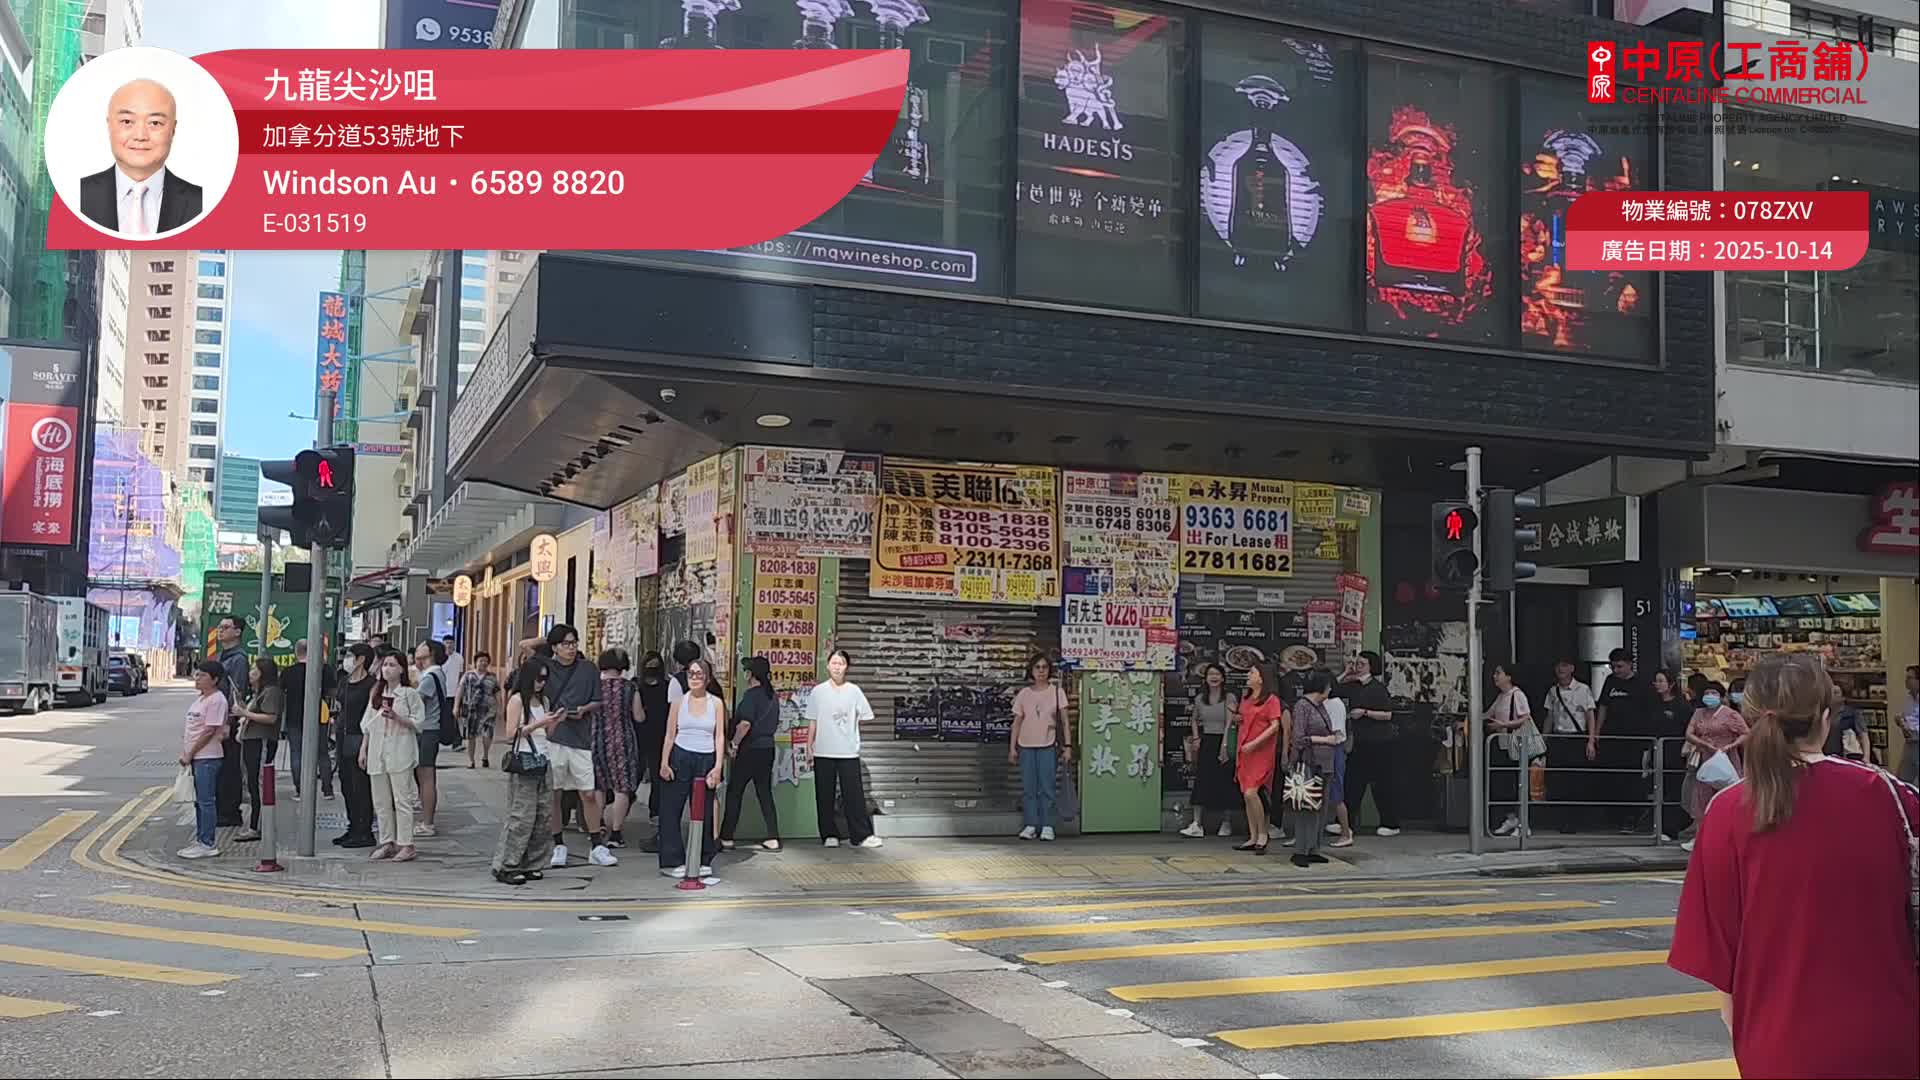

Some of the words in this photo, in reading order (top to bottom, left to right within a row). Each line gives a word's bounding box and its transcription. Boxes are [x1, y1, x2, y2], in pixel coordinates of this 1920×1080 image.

[43, 456, 64, 508] 海底撈
[1208, 480, 1247, 502] 永昇
[1251, 483, 1284, 494] Mutual
[1251, 493, 1291, 505] Property
[939, 508, 1050, 527] 8208-1838
[1096, 505, 1131, 518] 6895
[1136, 508, 1171, 520] 6018
[1186, 505, 1235, 529] 9363
[1243, 509, 1288, 532] 6681
[939, 521, 1050, 540] 8105-5645
[1096, 518, 1131, 530] 6748
[1136, 521, 1172, 533] 8306
[939, 534, 1050, 552] 8100-2396
[1187, 530, 1201, 545] 出
[1206, 531, 1227, 546] For
[1233, 533, 1271, 548] Lease
[1274, 534, 1288, 550] 租
[760, 560, 816, 575] 8208-1838
[966, 550, 1053, 570] 2311-7368
[1184, 550, 1290, 572] 27811682
[759, 590, 815, 605] 8105-5645
[1068, 599, 1102, 623] 何先生
[1105, 602, 1138, 627] 8226
[1636, 599, 1651, 616] 51
[757, 620, 814, 635] 8201-2688
